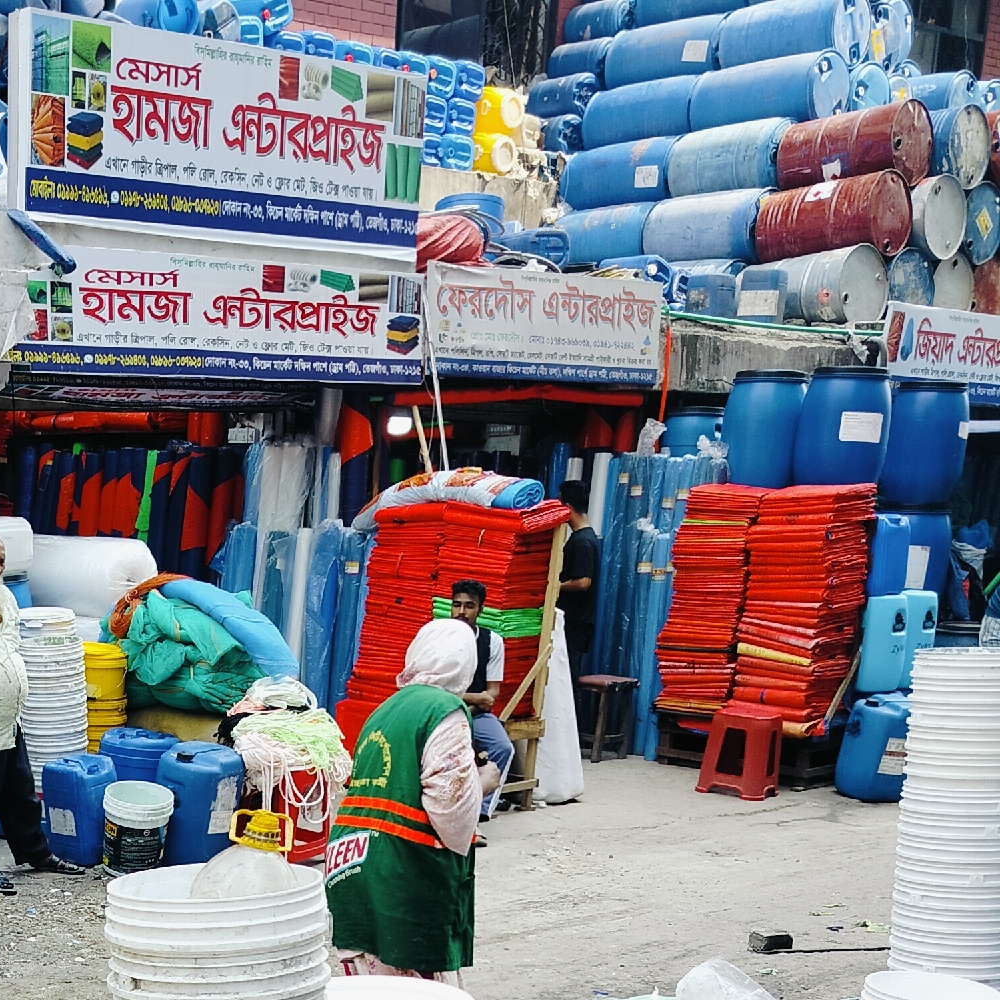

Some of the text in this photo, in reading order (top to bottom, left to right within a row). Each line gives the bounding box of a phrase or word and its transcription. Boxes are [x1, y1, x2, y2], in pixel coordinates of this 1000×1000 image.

[116, 57, 202, 91] মেসার্স
[111, 85, 385, 174] হামজা এন্টারপ্রাইজ
[105, 156, 129, 173] এখানে
[131, 156, 152, 178] গাড়ীর
[155, 157, 180, 182] ত্রিপাল,
[183, 162, 197, 181] পলি
[199, 167, 218, 186] রোল,
[251, 171, 264, 188] নেট
[267, 175, 272, 188] ও
[293, 176, 308, 196] মেট,
[342, 185, 361, 199] পাওয়া
[222, 199, 242, 217] দোকান
[266, 200, 283, 221] কিচেন
[285, 203, 302, 222] মার্কেট
[84, 267, 180, 288] মেসার্স
[79, 287, 381, 338] হামজা এন্টারপ্রাইজ
[437, 275, 656, 333] ফেরদৌস এন্টারপ্রাইজ
[77, 333, 101, 343] এখানে
[105, 331, 128, 344] গাড়ীর
[130, 332, 158, 347] ত্রিপাল,
[161, 332, 177, 345] পলি
[179, 335, 199, 348] রোল,
[235, 338, 249, 349] নেট
[252, 341, 258, 349] ও
[280, 341, 297, 353] মেট,
[335, 345, 355, 354] পাওয়া
[914, 317, 956, 366] জিয়াদ
[205, 357, 227, 368] দোকান
[252, 358, 272, 371] কিচেন
[273, 357, 293, 371] মার্কেট
[345, 866, 362, 877] Brush
